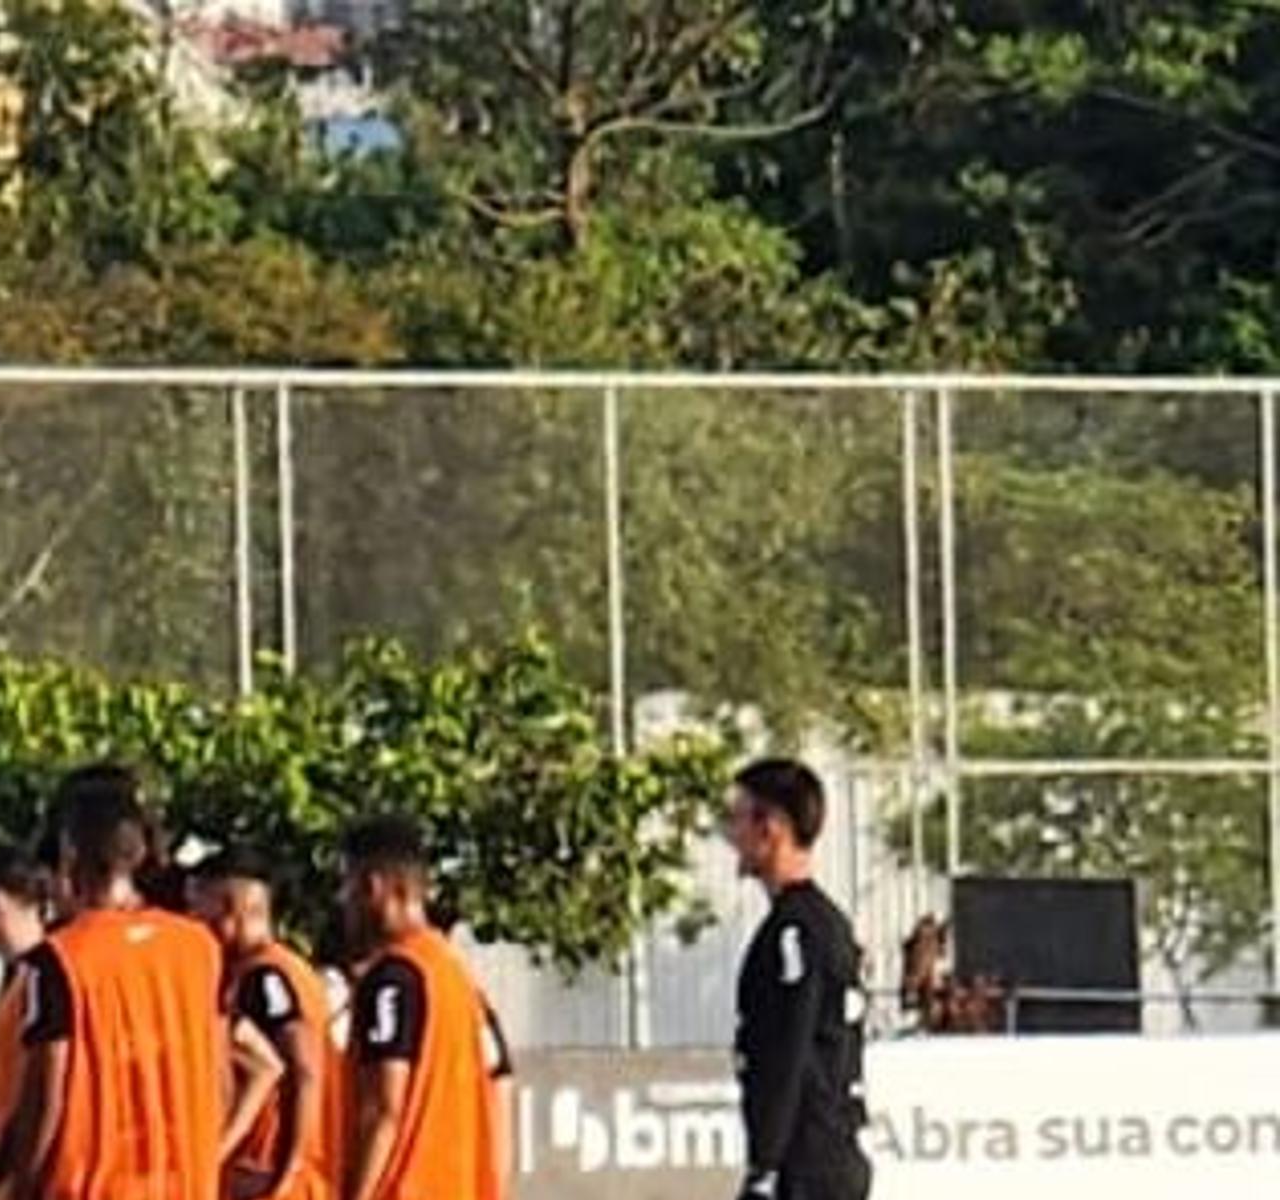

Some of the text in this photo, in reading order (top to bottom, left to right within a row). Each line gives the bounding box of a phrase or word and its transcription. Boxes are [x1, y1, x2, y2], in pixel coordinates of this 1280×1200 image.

[871, 1106, 1280, 1162] Abra sua con
